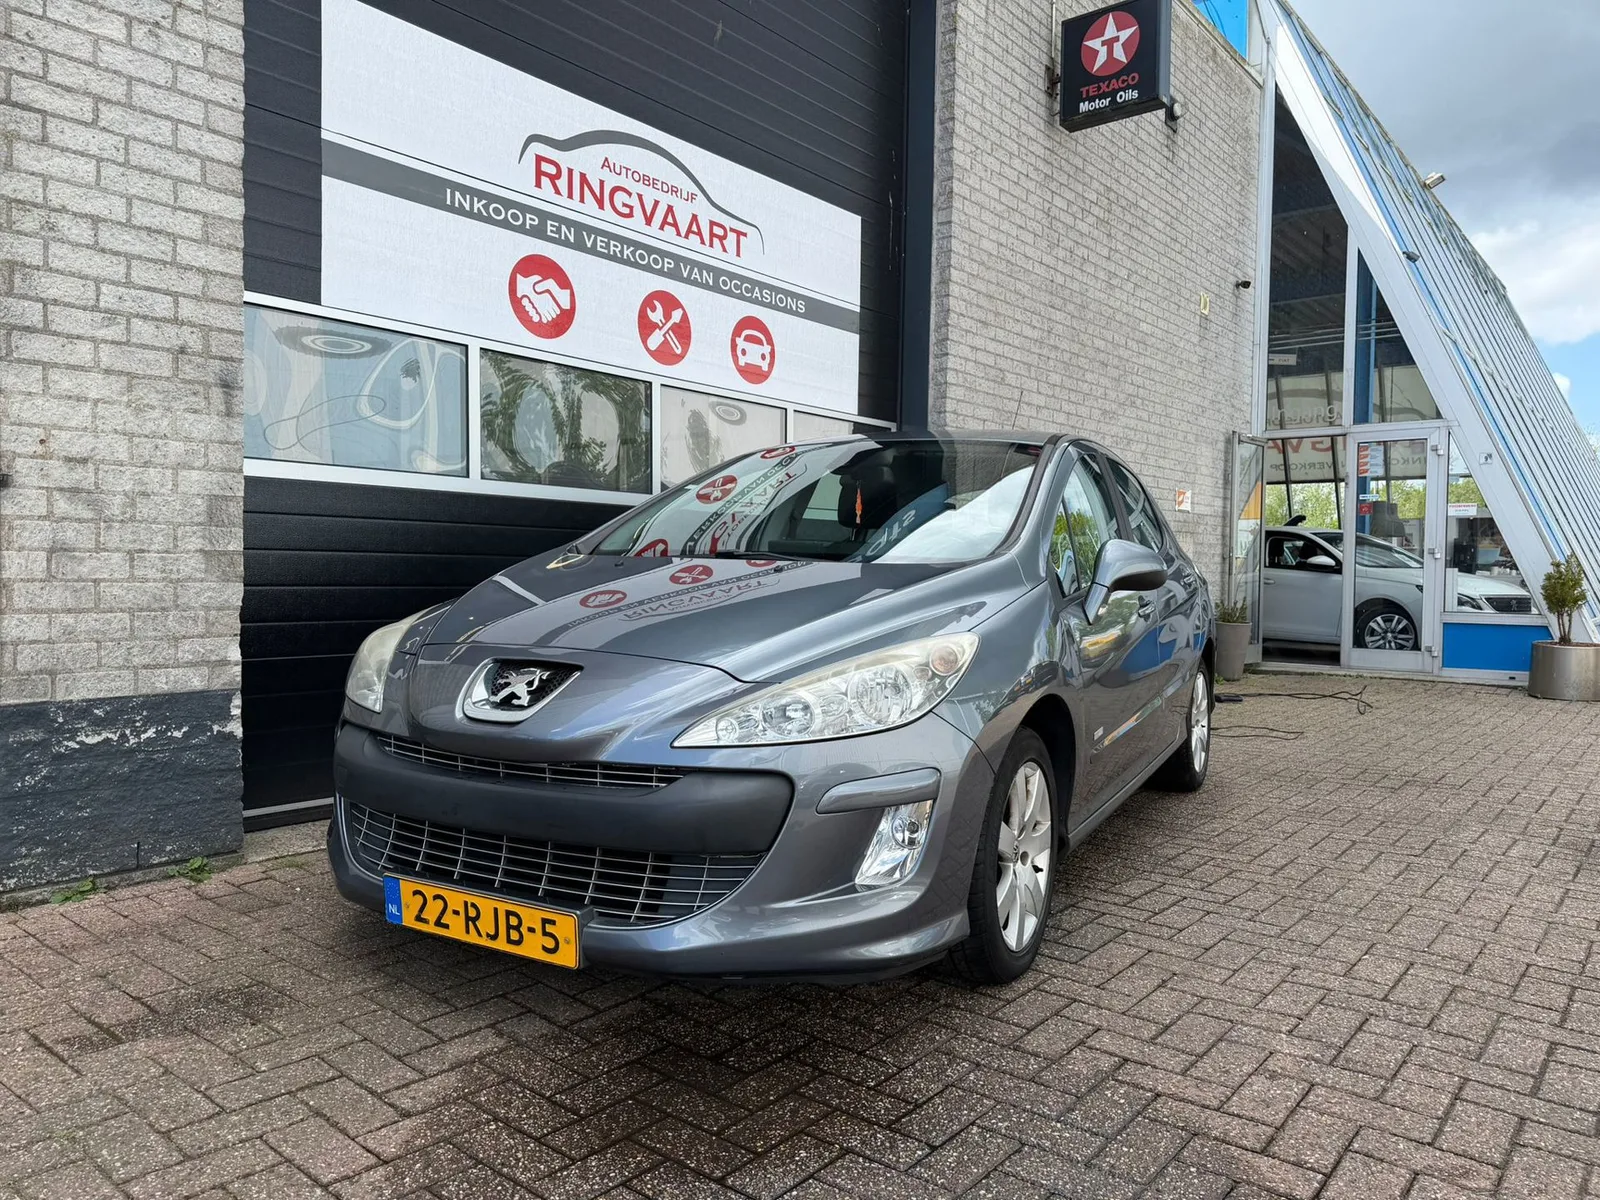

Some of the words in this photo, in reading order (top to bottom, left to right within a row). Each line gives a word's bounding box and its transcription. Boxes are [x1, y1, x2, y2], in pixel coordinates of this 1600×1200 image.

[1079, 96, 1112, 113] Motor
[1116, 89, 1139, 104] Oils
[1080, 72, 1140, 98] TEXACO
[601, 156, 698, 204] AUTOBEDRIJF
[533, 154, 748, 258] RINGVAART
[445, 188, 539, 230] INKOOP
[546, 219, 576, 244] EN
[582, 230, 675, 273] VERKOOP
[679, 262, 714, 286] VAN
[719, 276, 807, 313] OCCASIONS
[388, 903, 400, 916] NL
[411, 888, 561, 956] 22-RJB-5
